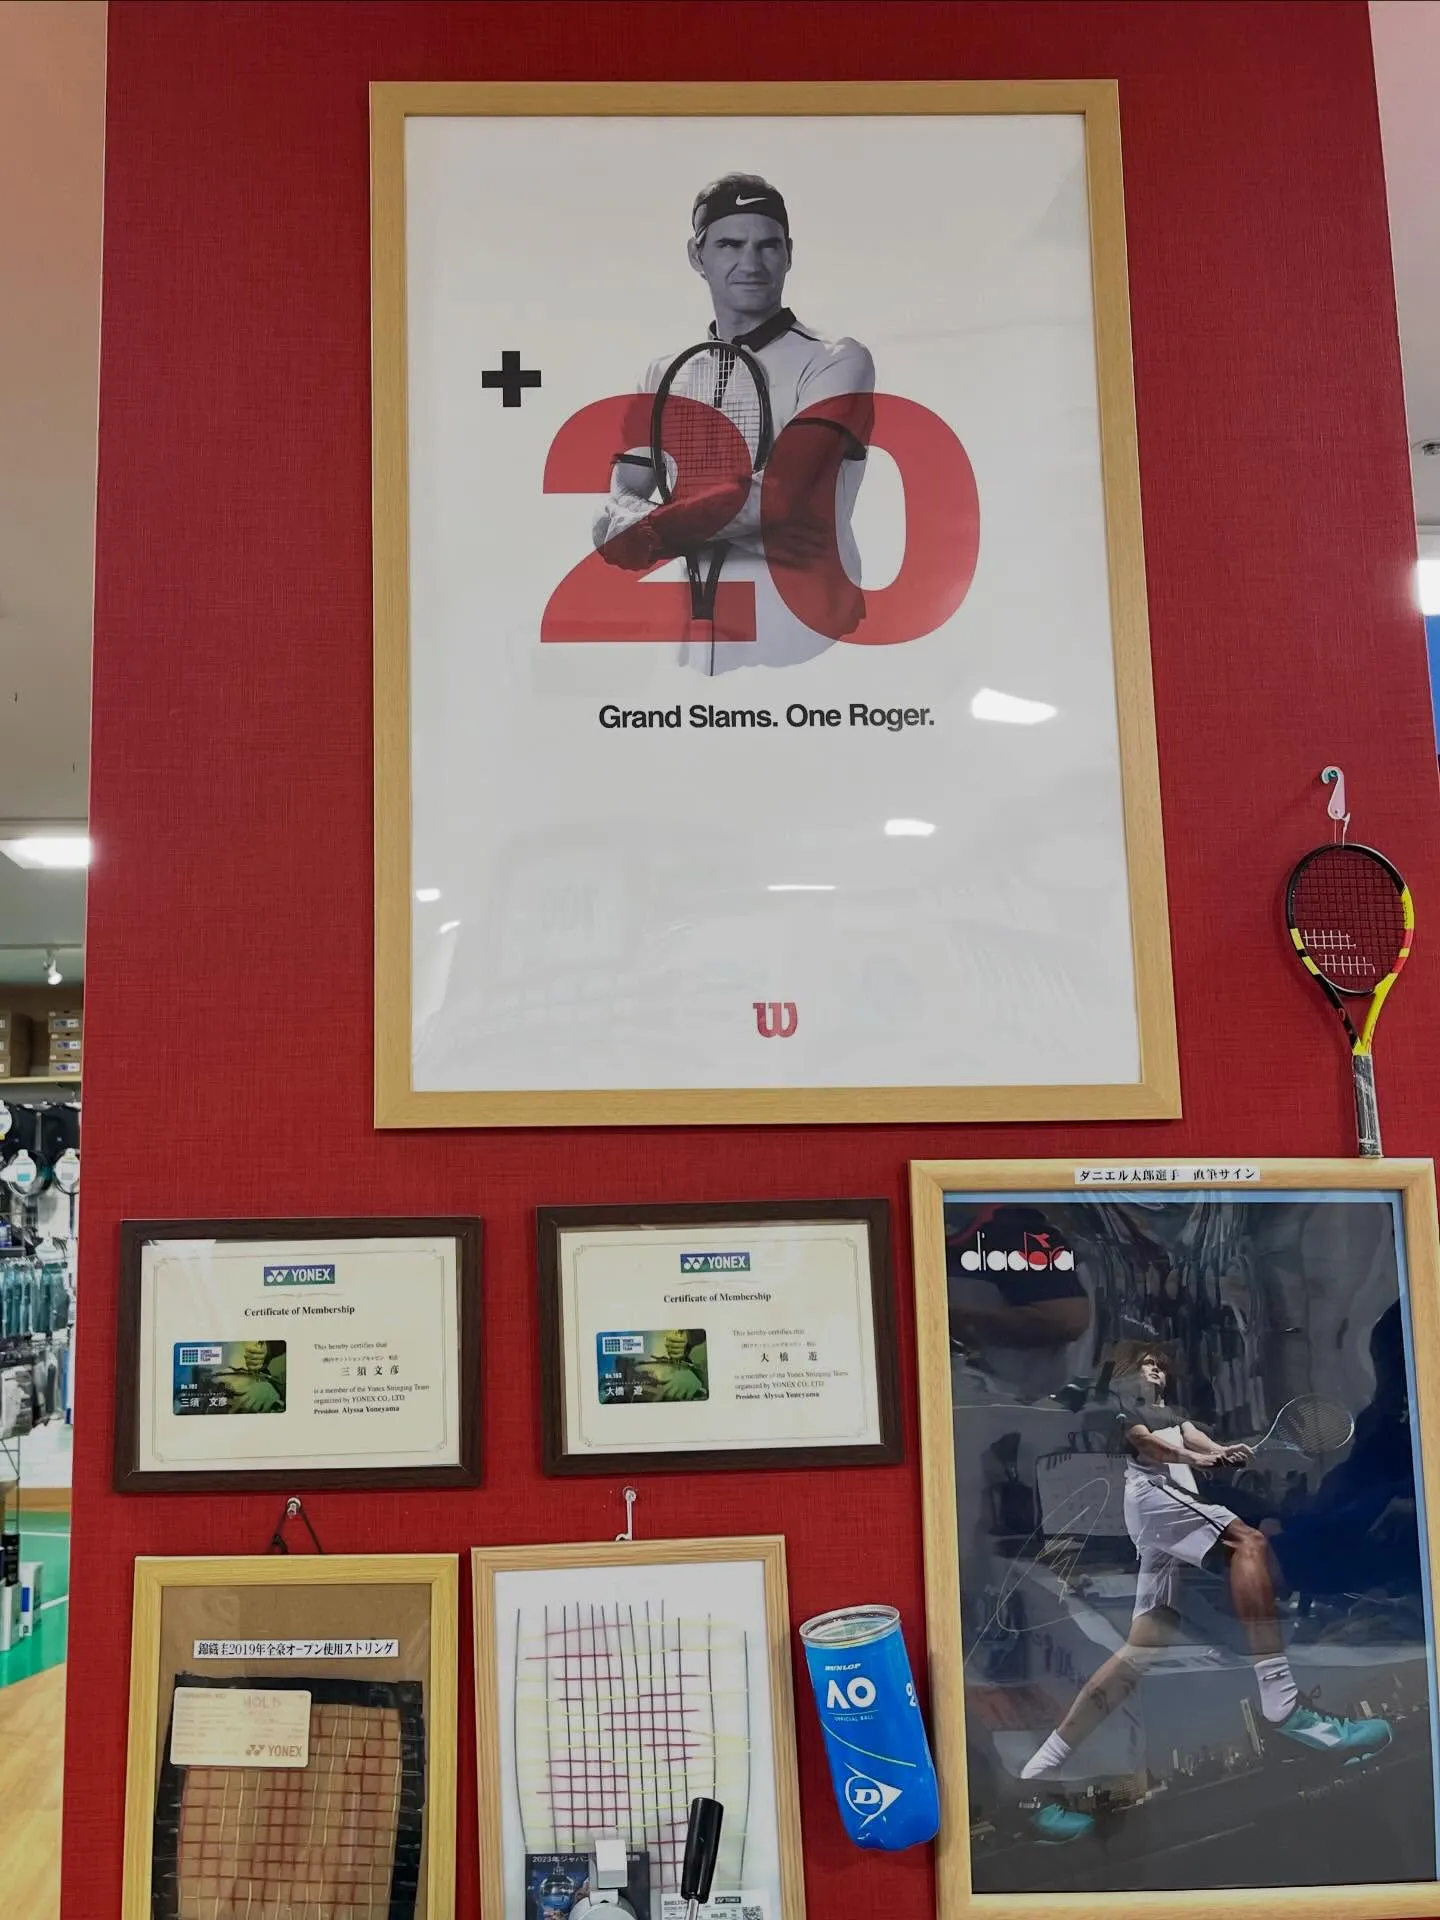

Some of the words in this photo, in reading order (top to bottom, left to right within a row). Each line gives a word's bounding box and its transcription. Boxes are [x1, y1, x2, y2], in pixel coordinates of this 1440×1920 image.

[541, 392, 980, 646] 20
[599, 704, 682, 728] Grand
[689, 704, 778, 728] Slams.
[785, 703, 842, 728] One
[848, 703, 935, 732] Roger.
[1079, 1169, 1179, 1182] ダニエル太郎選手
[1193, 1168, 1256, 1181] 直筆サイン
[960, 1231, 1075, 1272] diadora
[707, 1255, 746, 1269] YONEX
[291, 1268, 331, 1282] YONEX
[663, 1293, 708, 1303] Certificate
[709, 1293, 718, 1302] of
[719, 1292, 772, 1302] Membership
[244, 1307, 290, 1317] Certificate
[291, 1307, 301, 1315] of
[302, 1305, 355, 1315] Membership
[341, 1406, 364, 1414] Alyssa
[365, 1405, 400, 1413] Yoneyama
[824, 1663, 862, 1671] DUNLOP
[267, 1746, 303, 1758] YONEX
